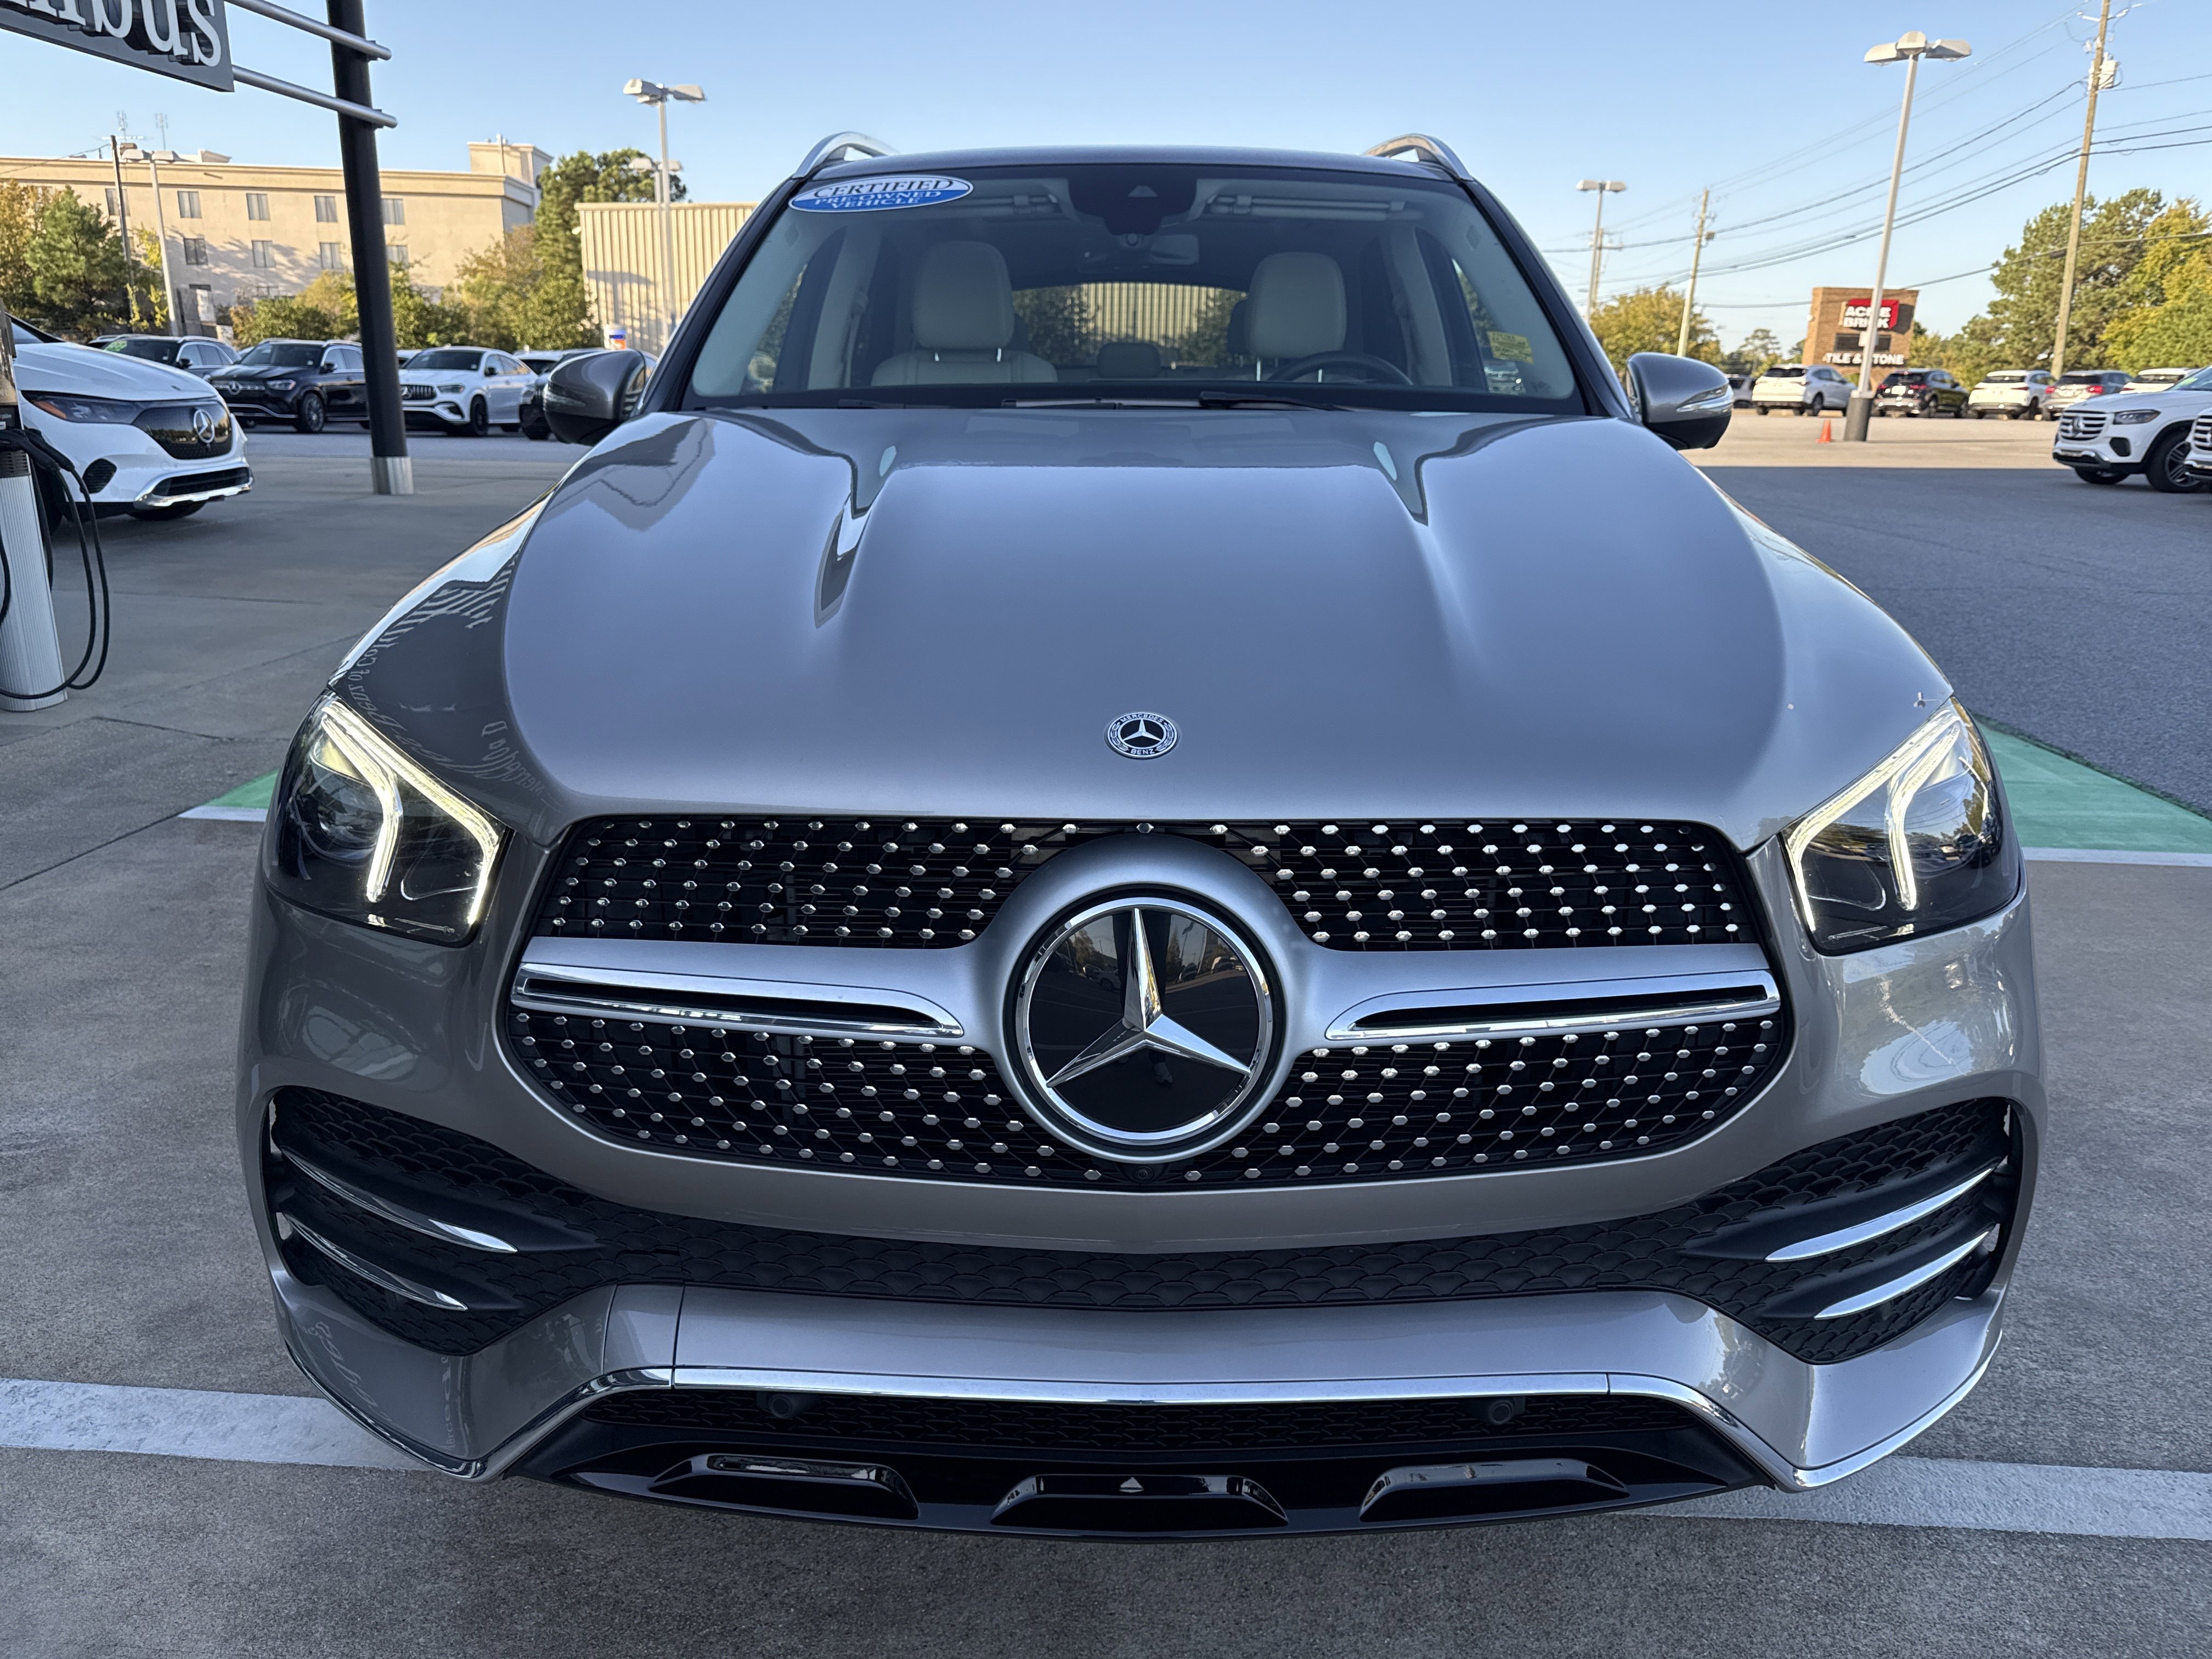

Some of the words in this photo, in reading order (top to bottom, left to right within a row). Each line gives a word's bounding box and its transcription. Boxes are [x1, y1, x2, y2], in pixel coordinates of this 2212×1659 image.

[814, 180, 953, 198] CERTIFIED
[814, 191, 942, 205] PRE-OWNED
[831, 198, 921, 208] VEHICLE
[1843, 317, 1889, 329] BRIK
[1826, 353, 1851, 364] TILE
[1852, 353, 1863, 364] &
[1870, 353, 1905, 365] TONE
[1120, 714, 1164, 723] MERCEDES
